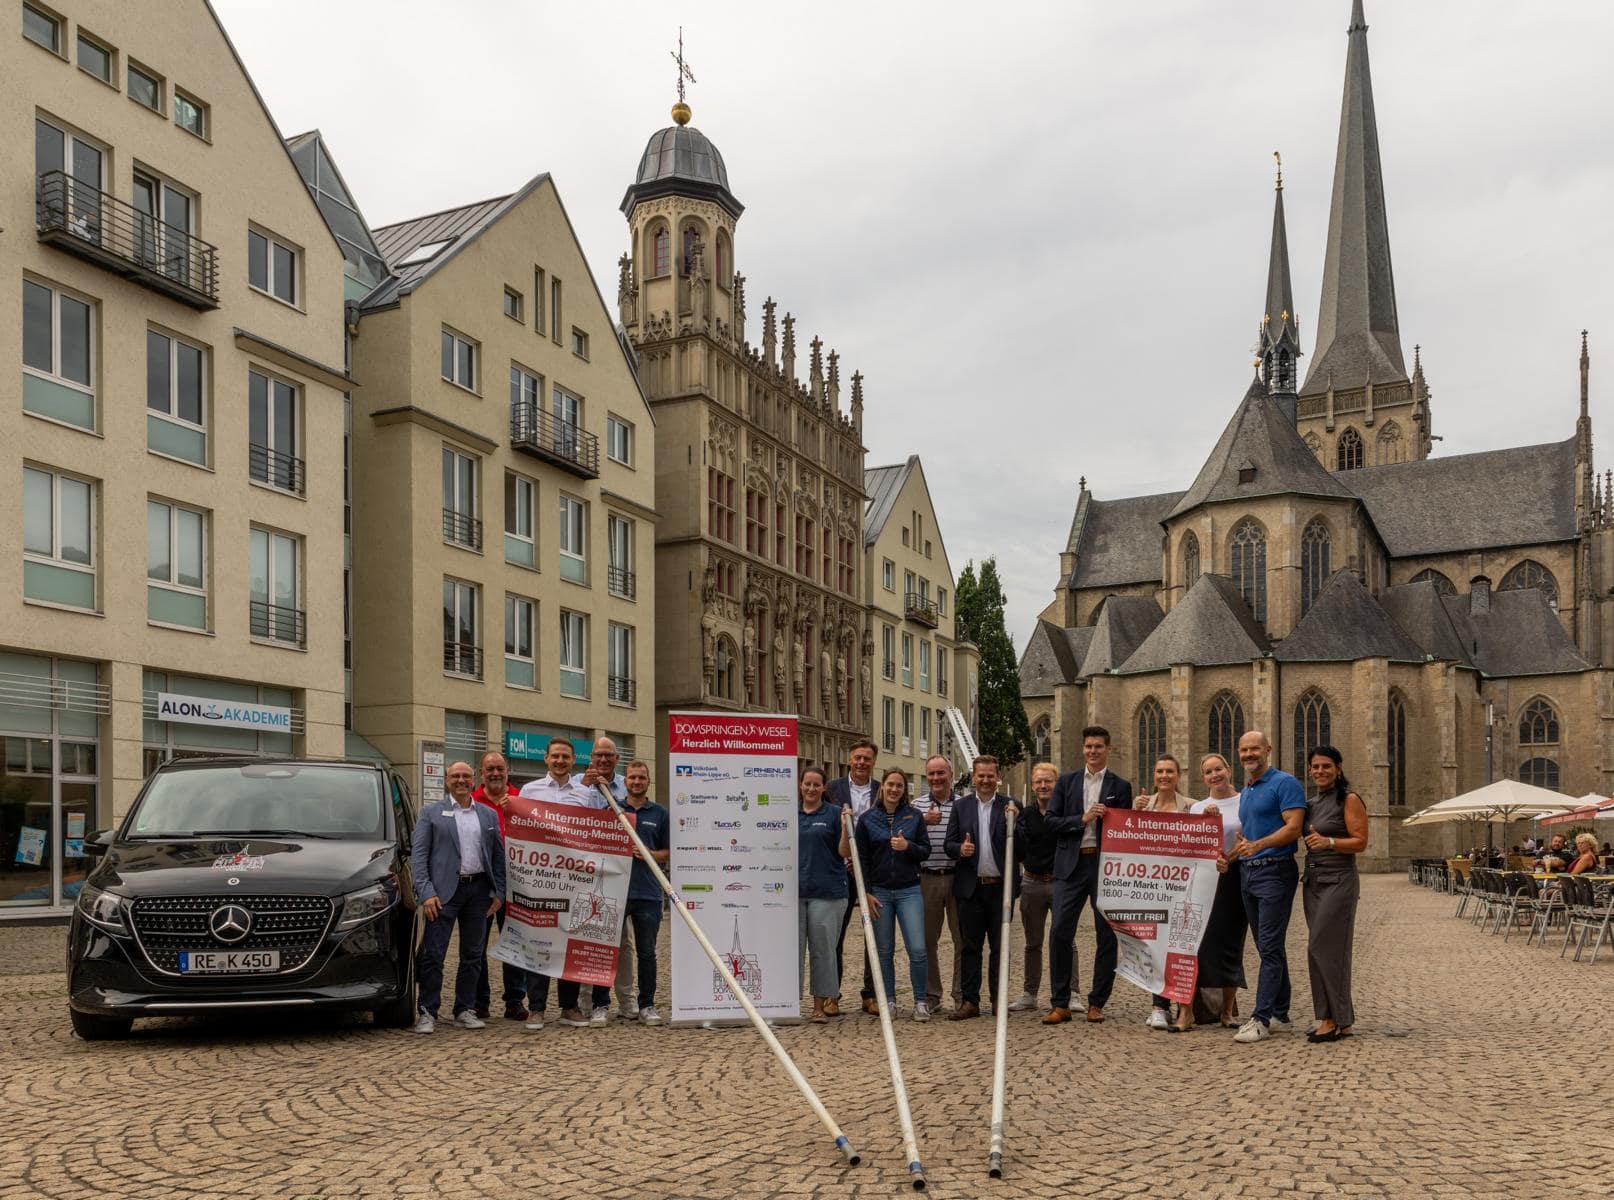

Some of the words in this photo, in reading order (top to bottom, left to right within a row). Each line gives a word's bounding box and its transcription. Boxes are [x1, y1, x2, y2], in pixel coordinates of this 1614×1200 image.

[161, 701, 201, 716] ALON
[223, 708, 289, 726] AKADEMIE
[675, 723, 748, 736] DOMSPRINGEN
[759, 726, 791, 737] WESEL
[510, 738, 525, 752] FOM
[682, 739, 720, 749] Herzlich
[723, 740, 785, 750] Willkommen!
[531, 808, 541, 818] 4.
[511, 815, 630, 843] Stabhochsprung-Meeting
[1125, 818, 1135, 828] 4.
[1138, 818, 1219, 833] Internationales
[1107, 829, 1219, 846] Stabhochsprung-Meeting
[509, 847, 596, 874] 01.09.2026
[535, 869, 561, 879] Markt
[568, 873, 594, 883] Wesel
[1104, 861, 1190, 881] 01.09.2026
[532, 879, 556, 890] 20.00
[559, 883, 576, 893] Uhr
[1103, 878, 1131, 887] Großer
[1133, 880, 1158, 889] Markt
[1130, 890, 1155, 901] 20.00
[1157, 892, 1173, 902] Uhr
[195, 954, 216, 968] RE
[228, 954, 238, 968] K
[242, 953, 272, 968] 450
